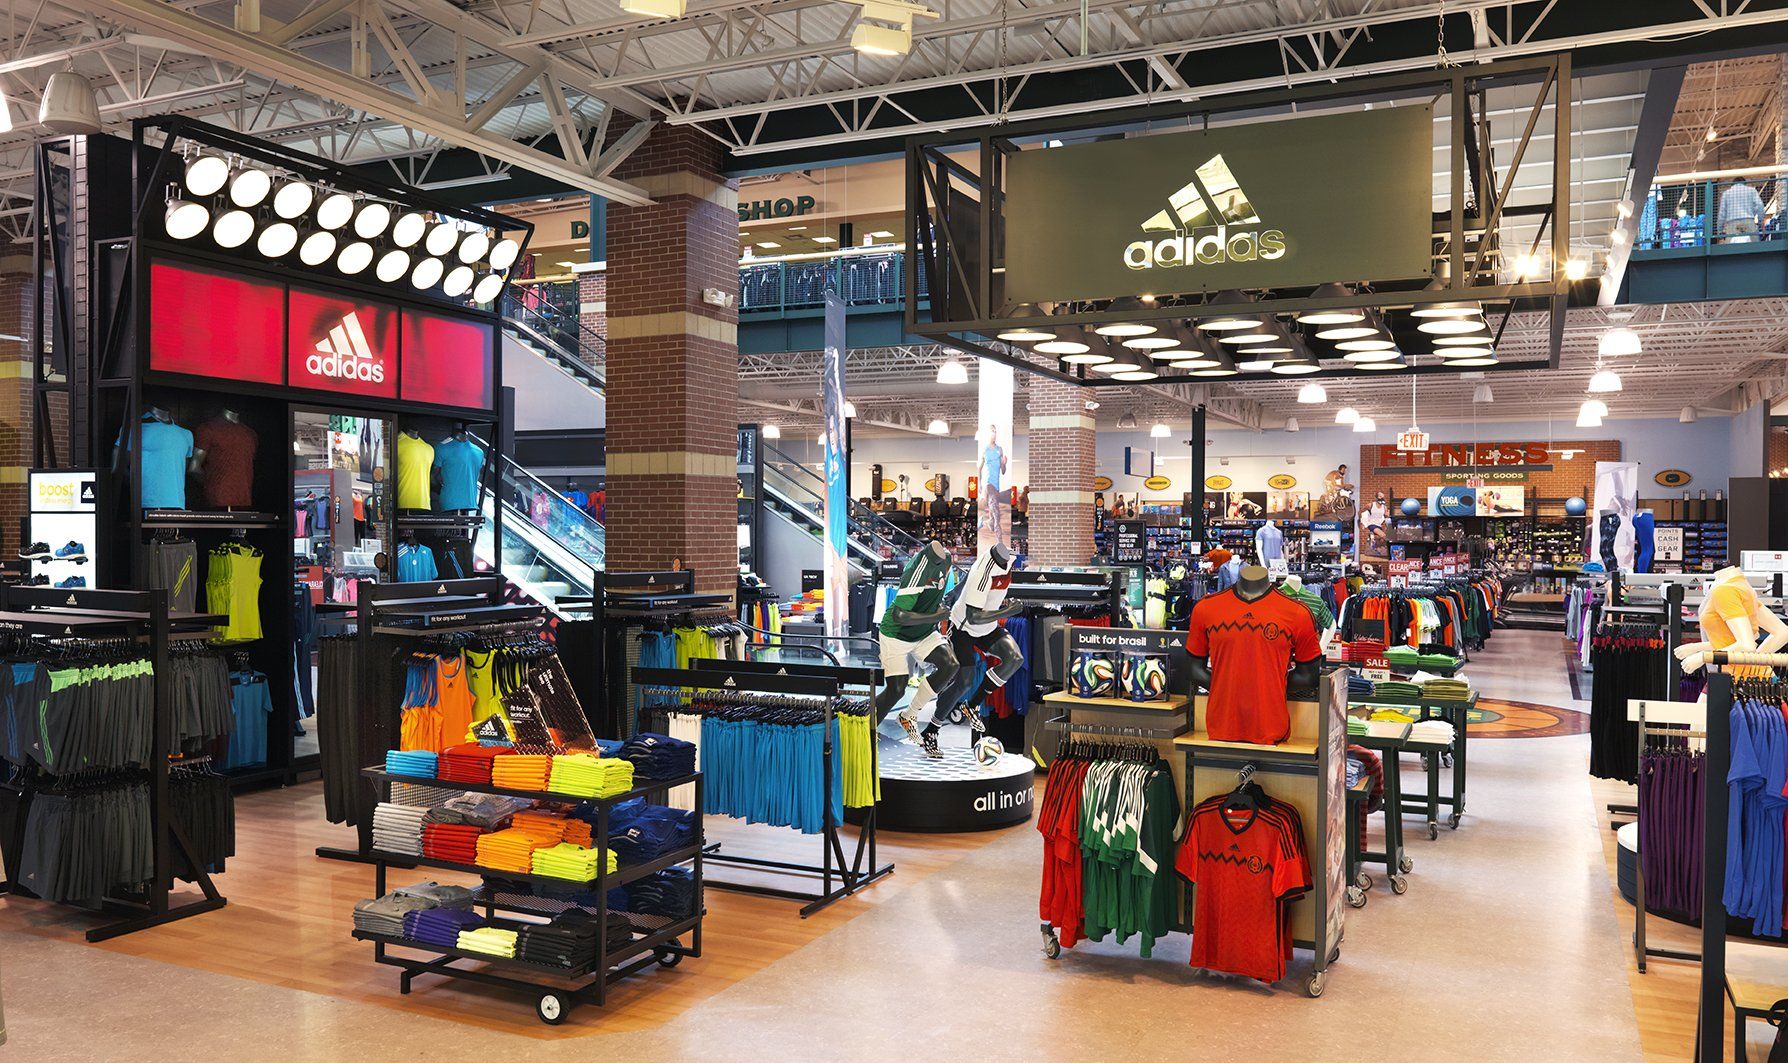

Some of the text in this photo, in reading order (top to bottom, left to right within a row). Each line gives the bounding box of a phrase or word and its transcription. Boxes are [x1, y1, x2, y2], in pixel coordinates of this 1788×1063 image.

[737, 196, 815, 221] SHOP
[1124, 225, 1286, 271] adidas
[306, 353, 384, 383] adidas
[1403, 434, 1424, 448] EXIT
[1380, 442, 1550, 466] FITNESS
[38, 482, 75, 496] boost
[1440, 495, 1458, 504] YOGA
[1079, 633, 1146, 646] built for brasil
[1366, 658, 1388, 667] SALE
[973, 791, 996, 812] all
[1000, 790, 1013, 809] in
[1015, 790, 1027, 806] or
